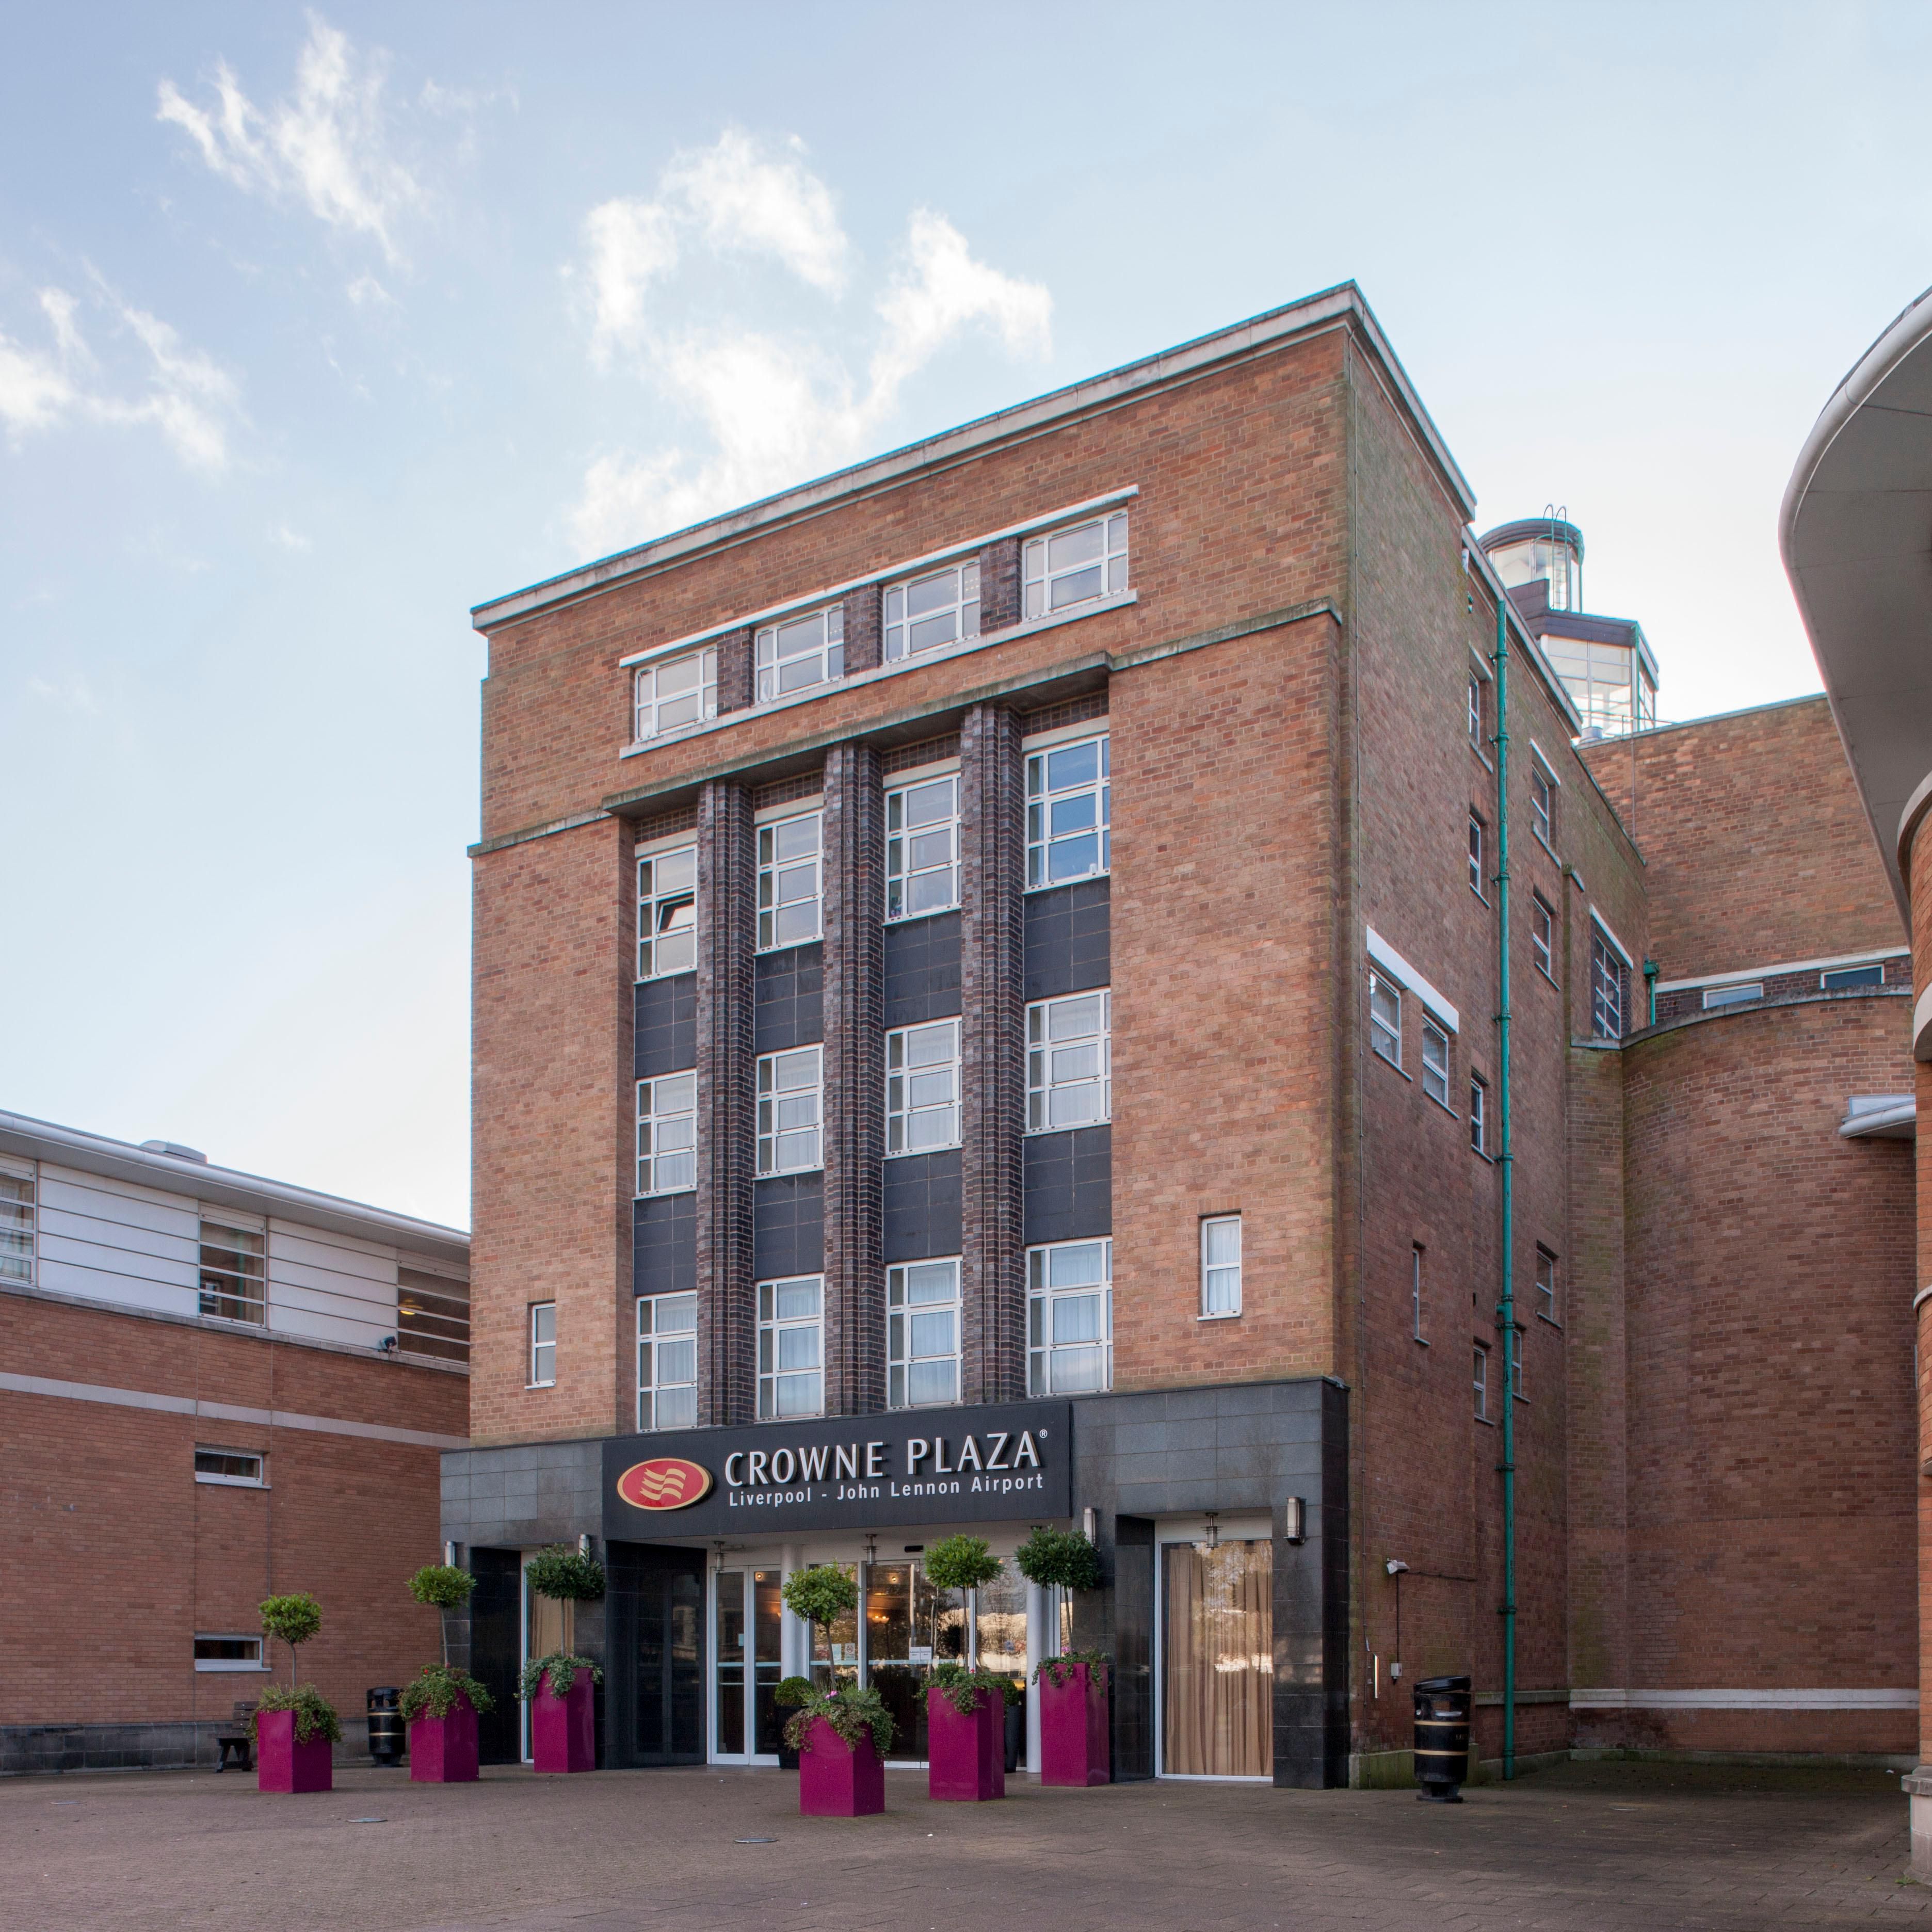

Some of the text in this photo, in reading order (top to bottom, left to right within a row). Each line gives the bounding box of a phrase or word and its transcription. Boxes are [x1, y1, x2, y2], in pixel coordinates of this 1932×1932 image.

[725, 1441, 884, 1487] CROWNE
[730, 1487, 811, 1507] Liverpool
[837, 1484, 879, 1500] John
[891, 1482, 959, 1497] Lennon
[971, 1473, 1043, 1494] Airport
